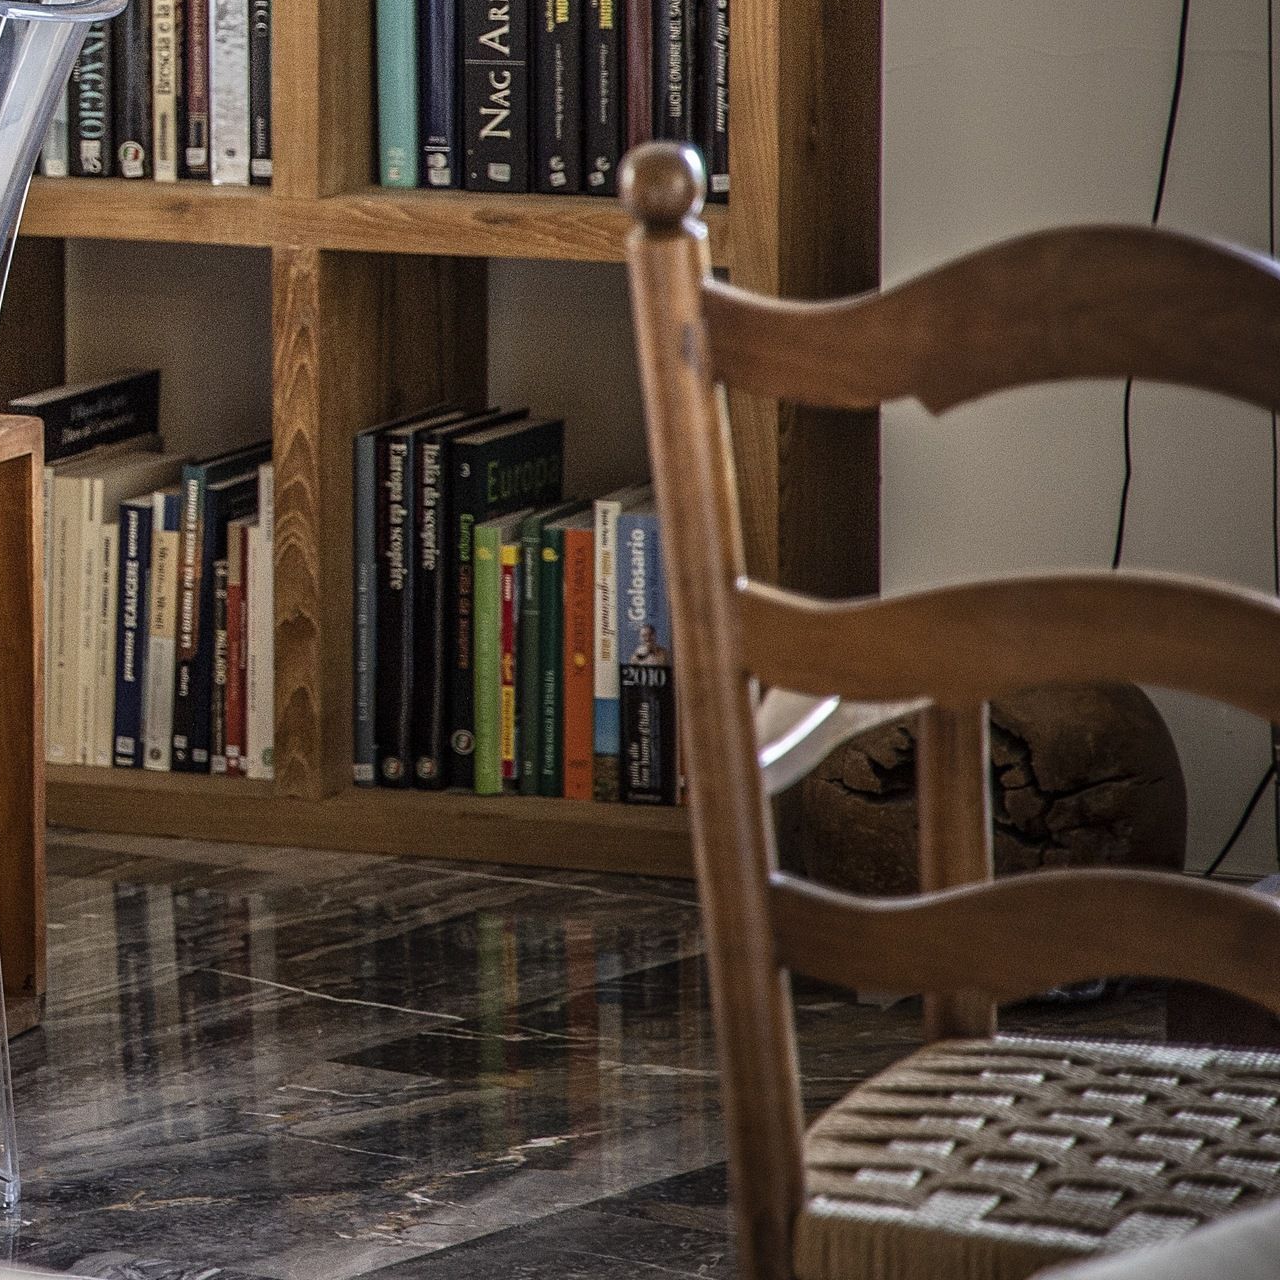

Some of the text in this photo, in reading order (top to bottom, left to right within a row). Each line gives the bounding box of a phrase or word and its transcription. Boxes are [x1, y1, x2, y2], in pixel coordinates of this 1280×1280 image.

[157, 5, 171, 19] la
[157, 23, 169, 33] e
[157, 37, 171, 96] Brescia
[385, 443, 408, 590] Europa da scoprire
[420, 443, 440, 570] Italia da scoprire
[627, 528, 647, 620] Golosario
[622, 667, 666, 688] 2010
